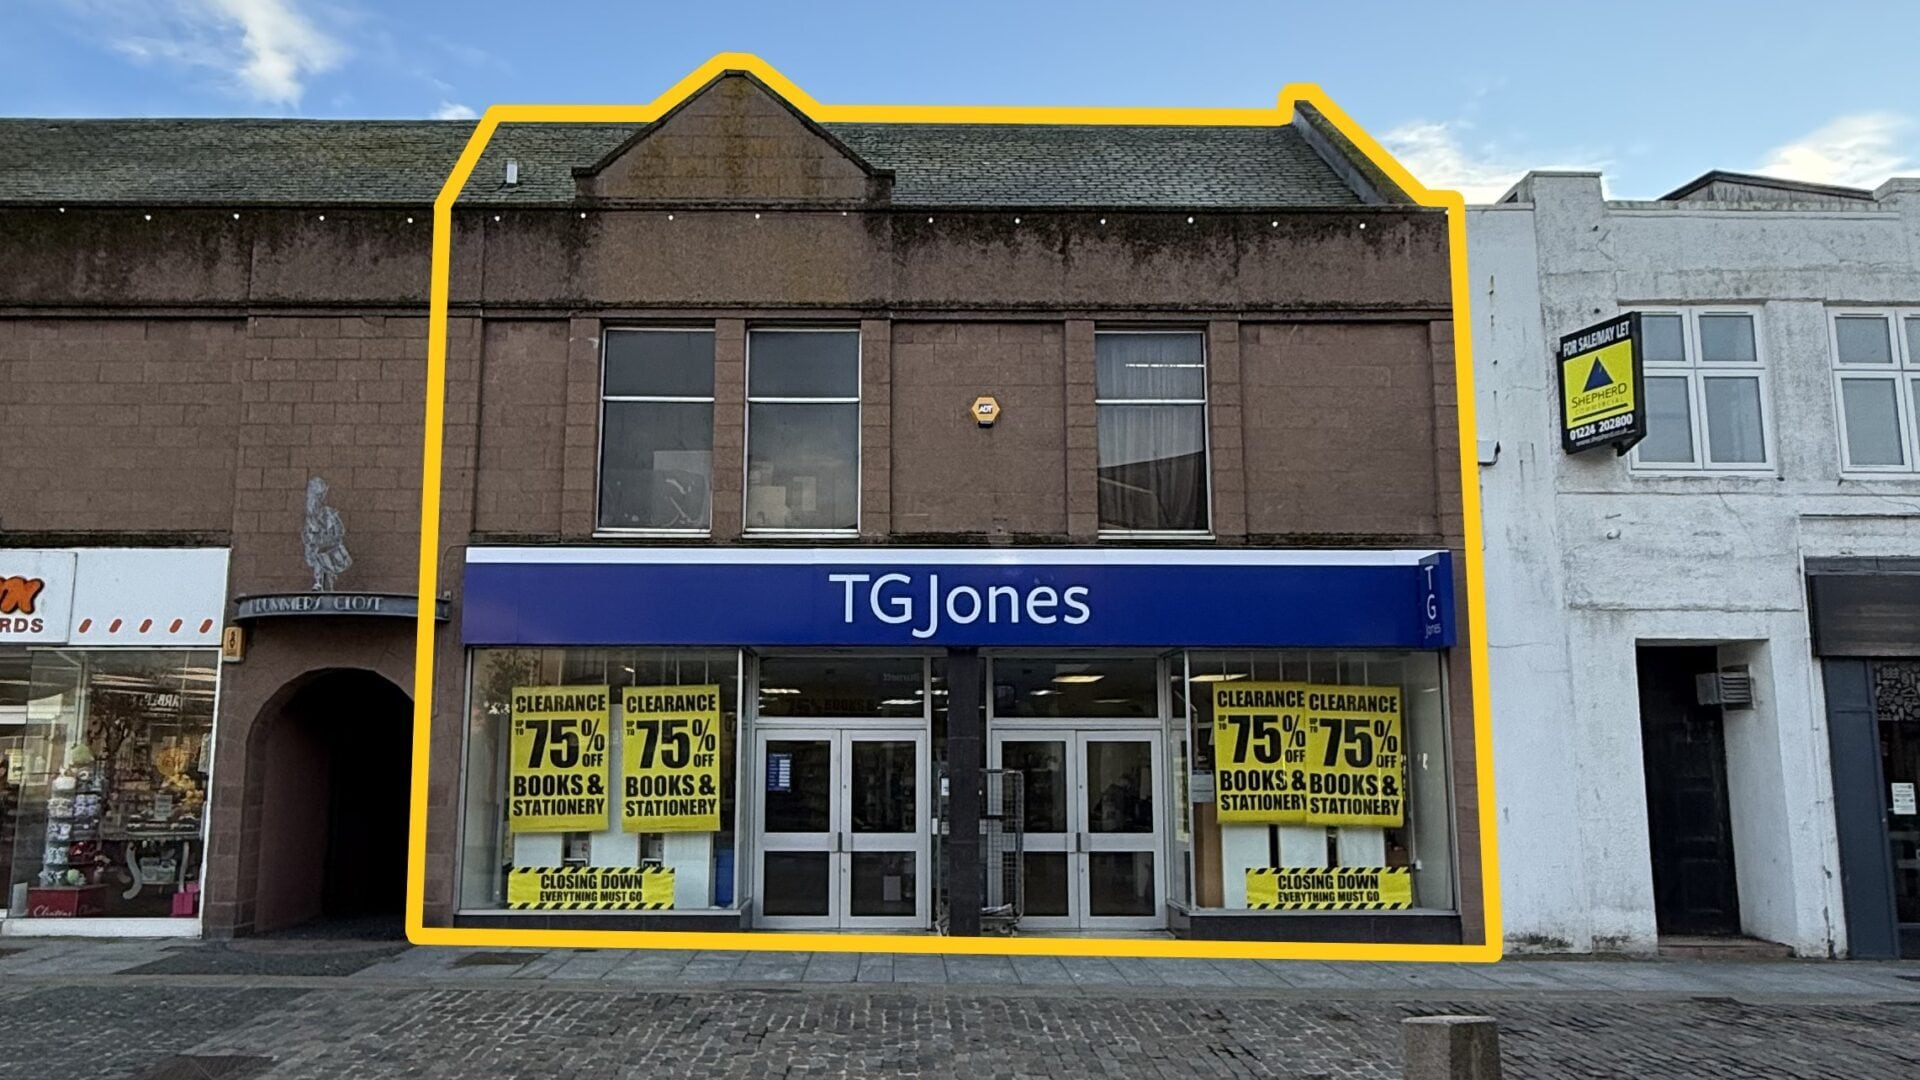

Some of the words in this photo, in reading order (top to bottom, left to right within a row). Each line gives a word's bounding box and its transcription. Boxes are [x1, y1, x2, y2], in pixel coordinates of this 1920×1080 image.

[1563, 340, 1577, 357] FOR
[1616, 321, 1630, 338] LET
[1571, 383, 1628, 408] SHEPHERD
[978, 404, 993, 413] ADT
[1570, 424, 1596, 441] 01224
[1599, 413, 1633, 432] 202800
[515, 694, 606, 713] CLEARANCE
[626, 694, 716, 713] CLEARANCE
[1217, 690, 1305, 708] CLEARANCE
[1309, 693, 1398, 713] CLEARANCE
[626, 728, 635, 736] TO
[1228, 714, 1306, 764] 75%
[525, 718, 605, 769] 75%
[636, 718, 716, 769] 75%
[1319, 718, 1398, 768] 75%
[582, 753, 604, 767] OFF
[693, 754, 715, 767] OFF
[1285, 749, 1306, 763] OFF
[1376, 754, 1397, 768] OFF
[514, 774, 583, 797] BOOKS
[587, 774, 604, 795] &
[625, 774, 695, 797] BOOKS
[698, 774, 716, 796] &
[1219, 769, 1288, 791] BOOKS
[1291, 769, 1306, 791] &
[1309, 773, 1378, 796] BOOKS
[1382, 775, 1399, 797] &
[513, 798, 605, 816] STATIONERY
[625, 798, 717, 817] STATIONERY
[1220, 793, 1307, 811] STATIONERY
[1310, 797, 1400, 816] STATIONERY
[541, 874, 598, 889] CLOSING
[601, 874, 643, 889] DOWN
[1277, 874, 1334, 889] CLOSING
[1337, 874, 1379, 889] DOWN
[540, 891, 598, 902] EVERYTHING
[600, 891, 627, 902] MUST
[629, 891, 643, 902] GO
[1277, 891, 1336, 902] EVERYTHING
[1337, 891, 1364, 902] MUST
[1366, 891, 1380, 902] GO
